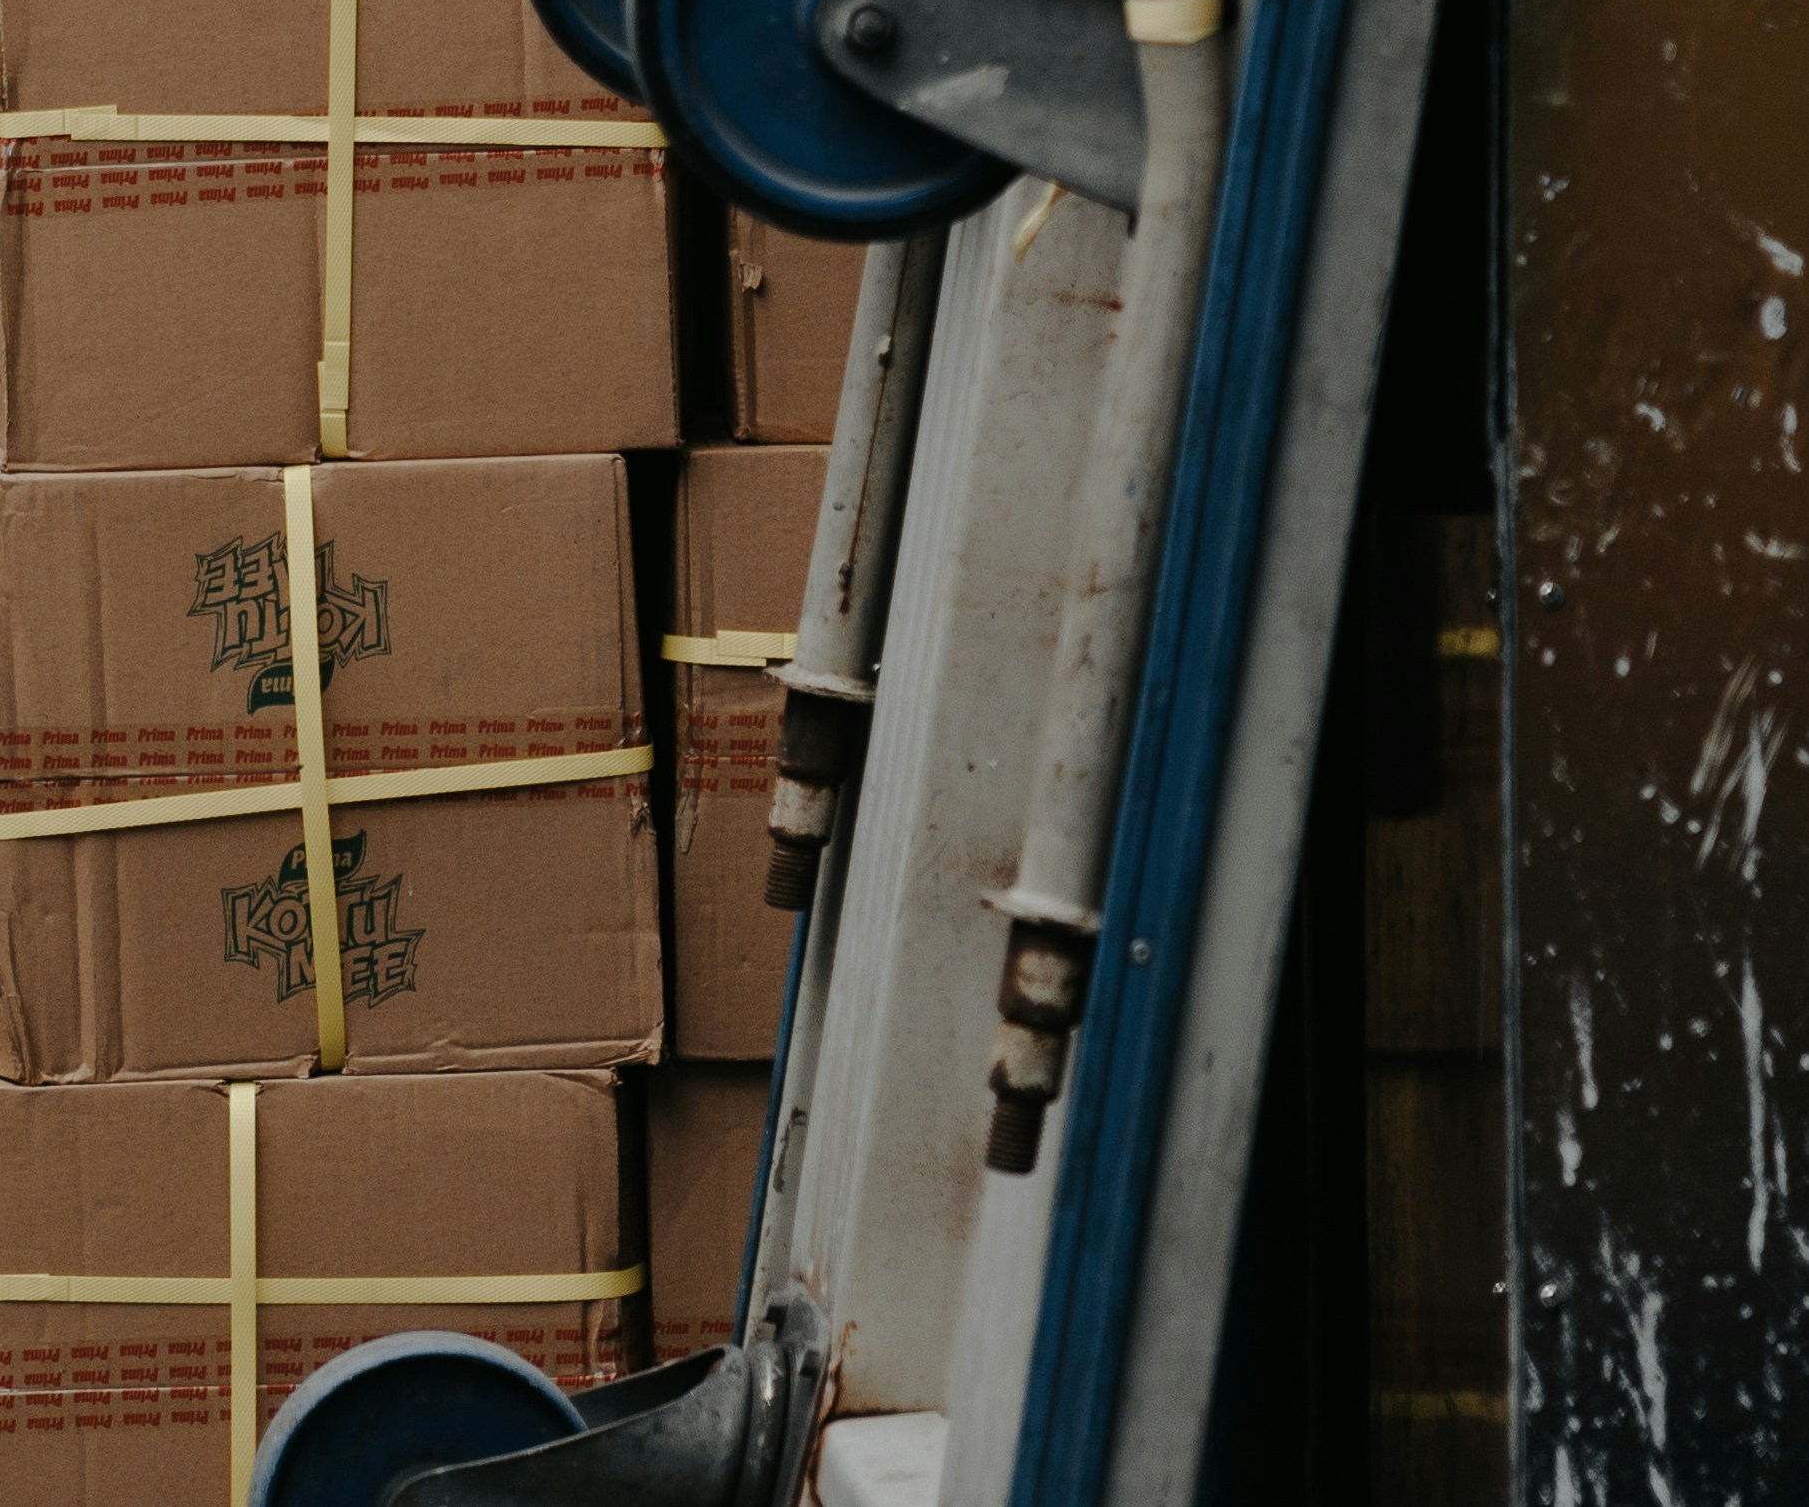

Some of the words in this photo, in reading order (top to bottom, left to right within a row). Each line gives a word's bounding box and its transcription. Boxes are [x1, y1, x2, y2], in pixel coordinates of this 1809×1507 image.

[484, 102, 522, 116] Prima
[533, 100, 570, 114] Prima
[581, 98, 618, 112] Prima
[51, 152, 88, 165] Prima
[99, 149, 136, 163] Prima
[147, 145, 184, 160] Prima
[52, 175, 89, 189] Prima
[101, 171, 138, 185] Prima
[149, 168, 186, 182] Prima
[197, 165, 234, 178] Prima
[245, 163, 281, 175] Prima
[390, 151, 427, 166] Prima
[54, 199, 91, 212] Prima
[103, 195, 139, 209] Prima
[151, 192, 187, 205] Prima
[199, 188, 236, 202] Prima
[247, 185, 284, 199] Prima
[391, 177, 429, 189] Prima
[440, 173, 477, 186] Prima
[488, 170, 525, 184] Prima
[537, 168, 574, 181] Prima
[585, 165, 622, 179] Prima
[42, 731, 79, 745] Prima
[91, 730, 127, 743] Prima
[138, 728, 175, 742] Prima
[187, 727, 223, 740] Prima
[235, 726, 272, 739] Prima
[333, 723, 369, 737] Prima
[380, 722, 417, 735] Prima
[429, 721, 466, 735] Prima
[479, 720, 515, 733] Prima
[527, 719, 564, 732] Prima
[575, 717, 612, 730] Prima
[729, 715, 766, 729] Prima
[729, 739, 767, 753] Prima
[43, 755, 79, 769] Prima
[91, 754, 127, 767] Prima
[139, 753, 175, 766] Prima
[188, 751, 224, 764] Prima
[236, 750, 272, 763] Prima
[332, 747, 370, 761] Prima
[381, 746, 418, 760] Prima
[430, 745, 467, 758] Prima
[479, 744, 516, 758] Prima
[578, 785, 614, 798] Prima
[730, 778, 768, 792] Prima
[231, 890, 394, 960] KOTU
[23, 1349, 60, 1363] Prima
[71, 1346, 109, 1360] Prima
[120, 1344, 157, 1358] Prima
[168, 1341, 206, 1356] Prima
[265, 1338, 303, 1352] Prima
[506, 1330, 544, 1344] Prima
[25, 1373, 62, 1387] Prima
[72, 1370, 110, 1384] Prima
[121, 1367, 158, 1382] Prima
[169, 1366, 207, 1380] Prima
[265, 1362, 303, 1376] Prima
[26, 1394, 63, 1407] Prima
[74, 1393, 111, 1405] Prima
[122, 1391, 159, 1402] Prima
[170, 1388, 207, 1401] Prima
[27, 1417, 64, 1430] Prima
[75, 1414, 113, 1429] Prima
[123, 1412, 161, 1426] Prima
[172, 1410, 209, 1424] Prima
